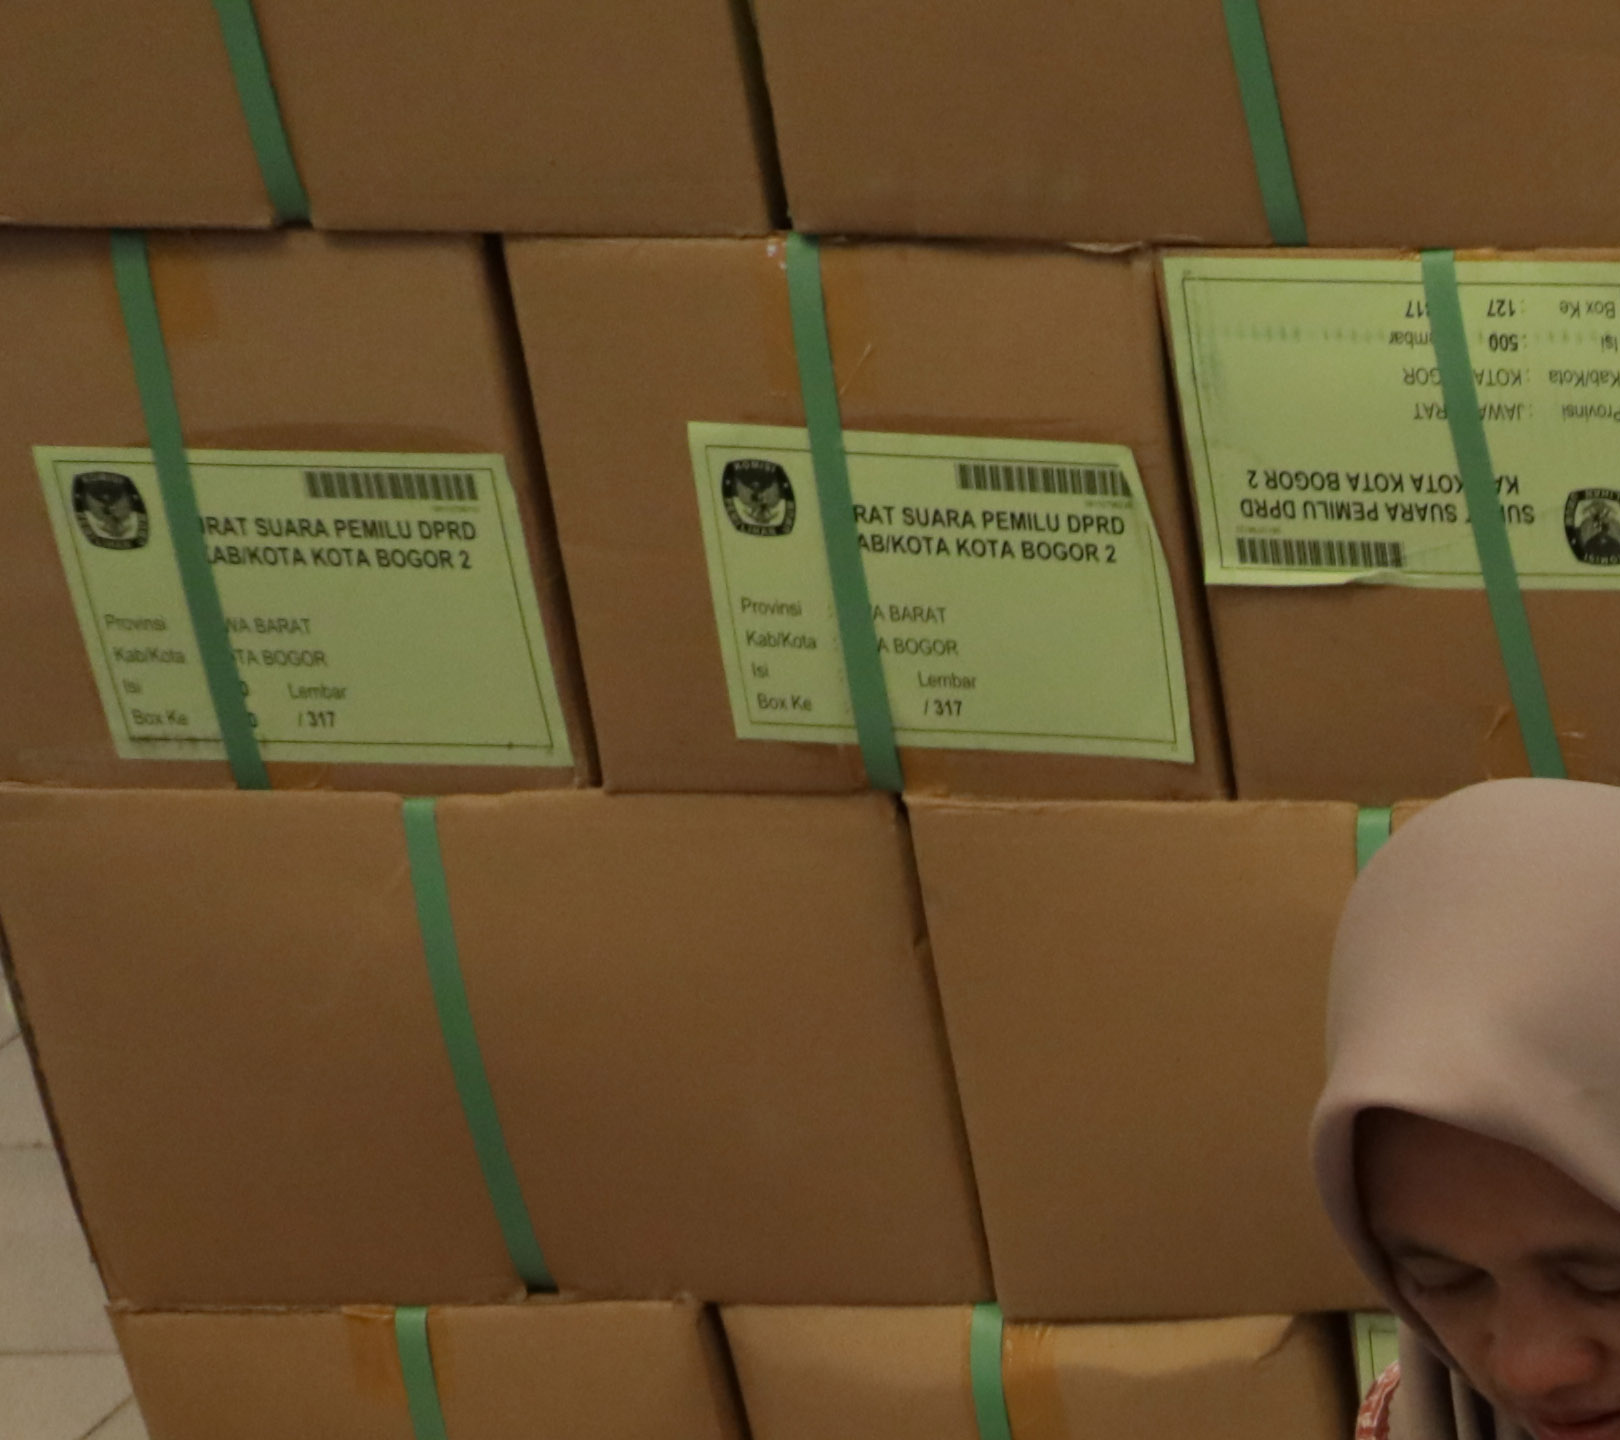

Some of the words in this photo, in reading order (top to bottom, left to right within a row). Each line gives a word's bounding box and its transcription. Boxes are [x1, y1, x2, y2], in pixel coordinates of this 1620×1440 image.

[1487, 300, 1516, 317] 127
[1560, 302, 1580, 318] Ke
[1587, 300, 1616, 318] Box
[1489, 334, 1519, 351] 500
[1549, 369, 1620, 386] Kab/Kota
[1247, 470, 1259, 488] 2
[1265, 472, 1341, 490] BOGOR
[1347, 473, 1404, 491] KOTA
[1241, 499, 1296, 519] DPRD
[1304, 502, 1379, 521] PEMILU
[1385, 503, 1457, 523] SUARA
[255, 518, 330, 539] SUARA
[334, 519, 413, 540] PEMILU
[419, 520, 477, 541] DPRD
[903, 505, 976, 528] SUARA
[982, 509, 1059, 532] PEMILU
[1068, 513, 1125, 535] DPRD
[857, 533, 950, 556] AB/KOTA
[957, 537, 1015, 559] KOTA
[1021, 540, 1099, 562] BOGOR
[1105, 543, 1117, 563] 2
[206, 546, 307, 567] AB/KOTA
[313, 547, 370, 568] KOTA
[377, 548, 453, 569] BOGOR
[458, 550, 471, 570] 2
[741, 597, 801, 617] Provinsi
[890, 605, 945, 623] BARAT
[104, 614, 166, 633] Provinsi
[254, 618, 311, 634] BARAT
[746, 630, 817, 649] Kab/Kota
[894, 637, 957, 655] BOGOR
[115, 647, 185, 665] Kab/Kota
[263, 649, 327, 666] BOGOR
[918, 671, 976, 689] Lembar
[289, 683, 346, 700] Lembar
[757, 693, 788, 711] Box
[792, 694, 812, 712] Ke
[934, 699, 962, 717] 317
[308, 710, 336, 728] 317
